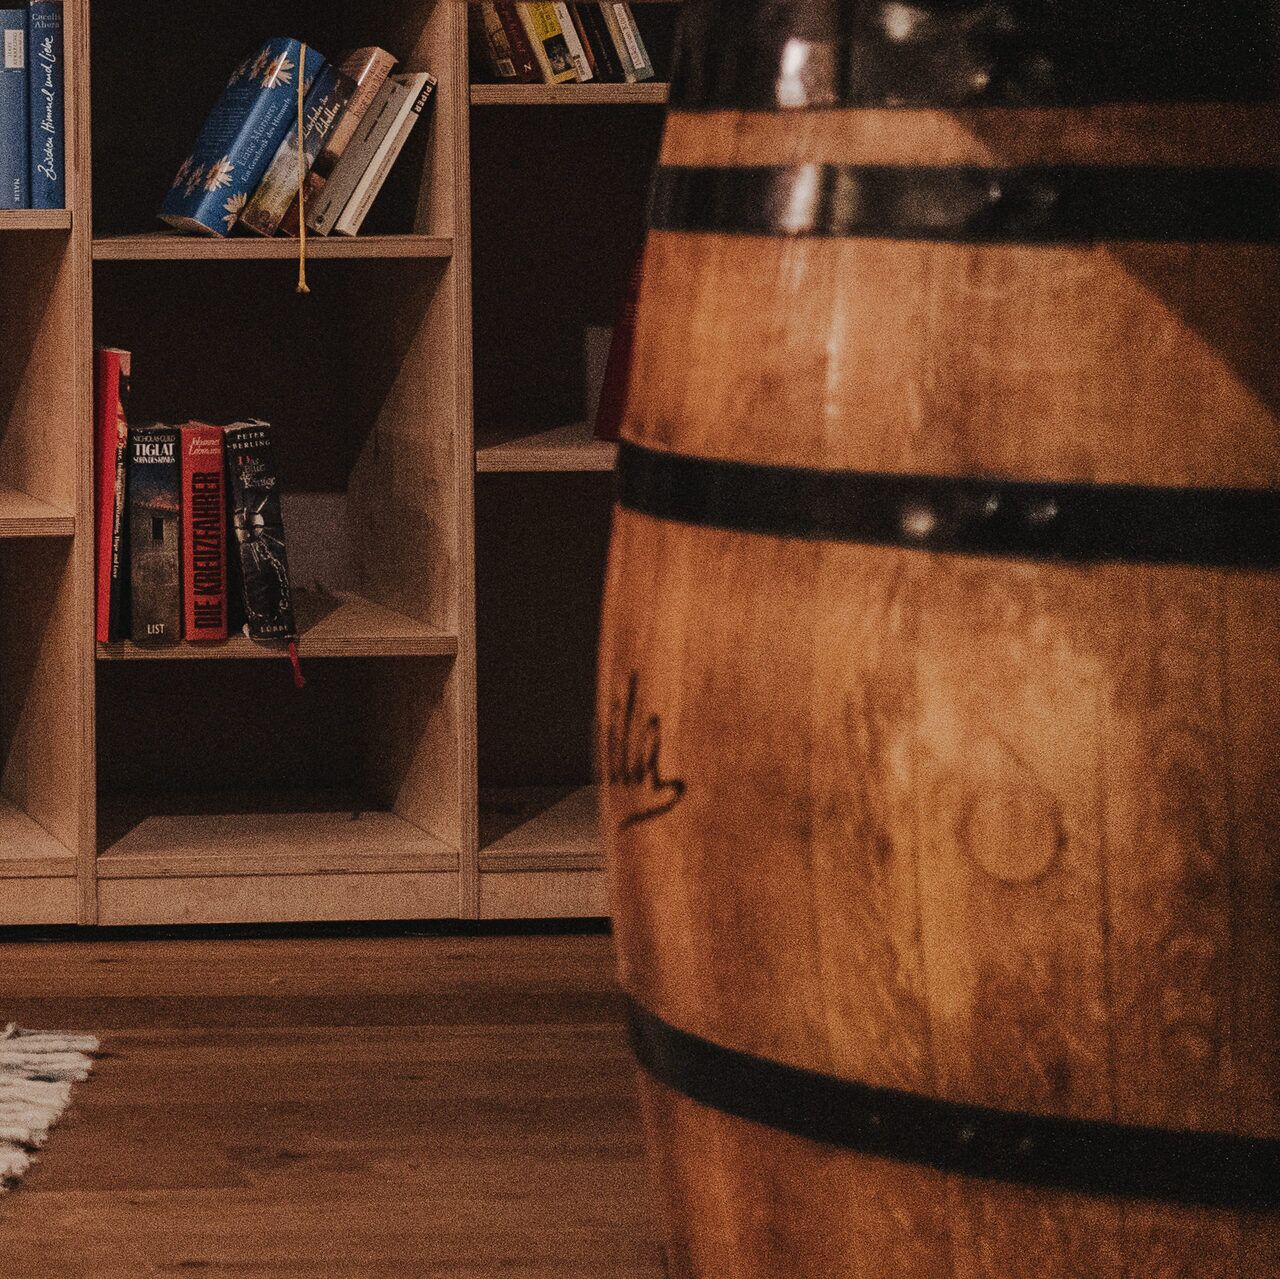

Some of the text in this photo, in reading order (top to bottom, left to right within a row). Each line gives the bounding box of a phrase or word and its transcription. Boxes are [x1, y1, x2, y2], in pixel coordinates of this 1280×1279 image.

[37, 36, 56, 180] Zwischen Himmel und Liebe
[414, 84, 434, 114] PIPER
[236, 432, 265, 440] PETER
[134, 443, 175, 456] TIGLAT
[192, 472, 222, 628] DIE KREUZFAHRER
[147, 624, 164, 634] LIST
